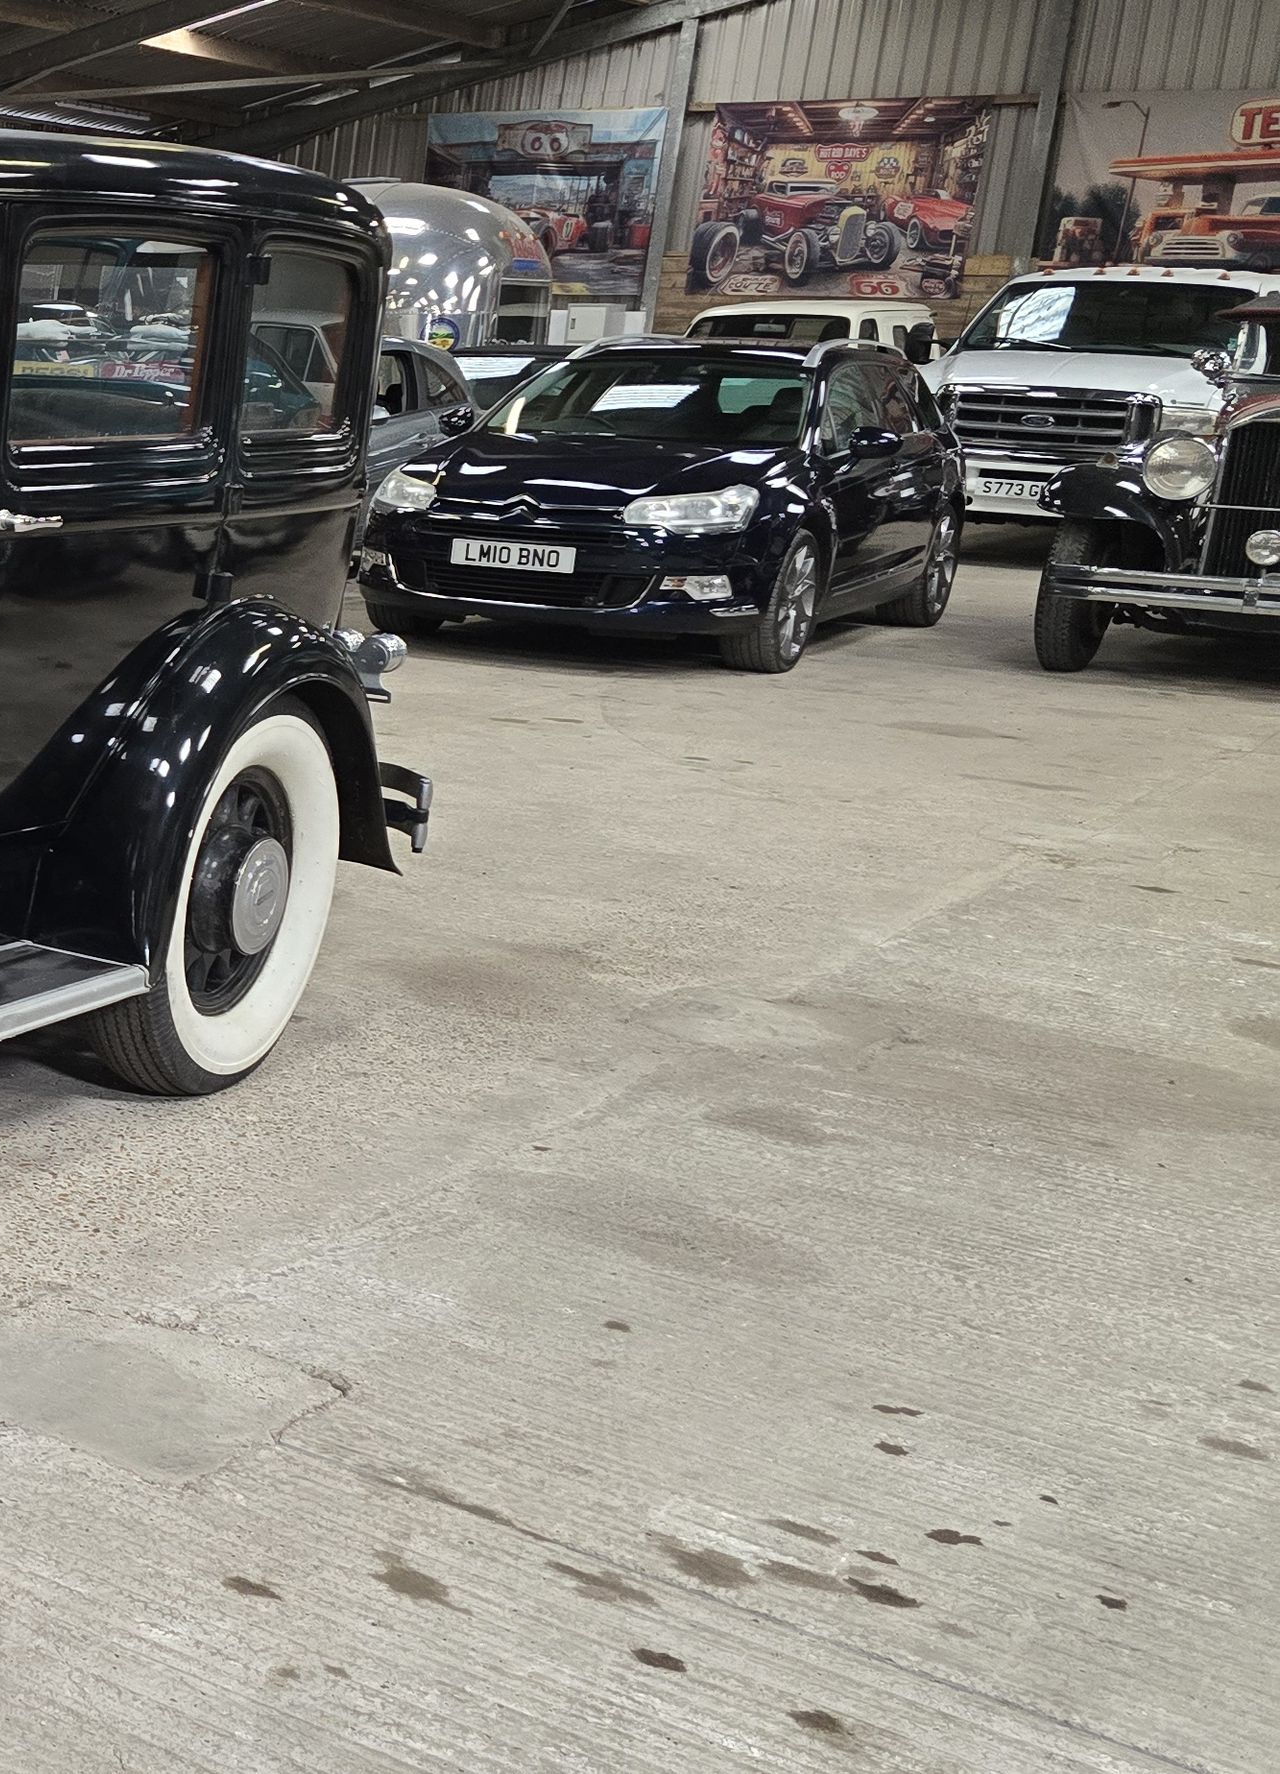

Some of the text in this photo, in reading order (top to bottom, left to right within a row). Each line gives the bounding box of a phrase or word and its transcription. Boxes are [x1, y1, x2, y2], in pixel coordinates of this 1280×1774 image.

[1240, 105, 1280, 140] TE
[114, 366, 133, 377] Dr
[982, 480, 1025, 497] S773
[465, 543, 560, 568] LM10 BNO
